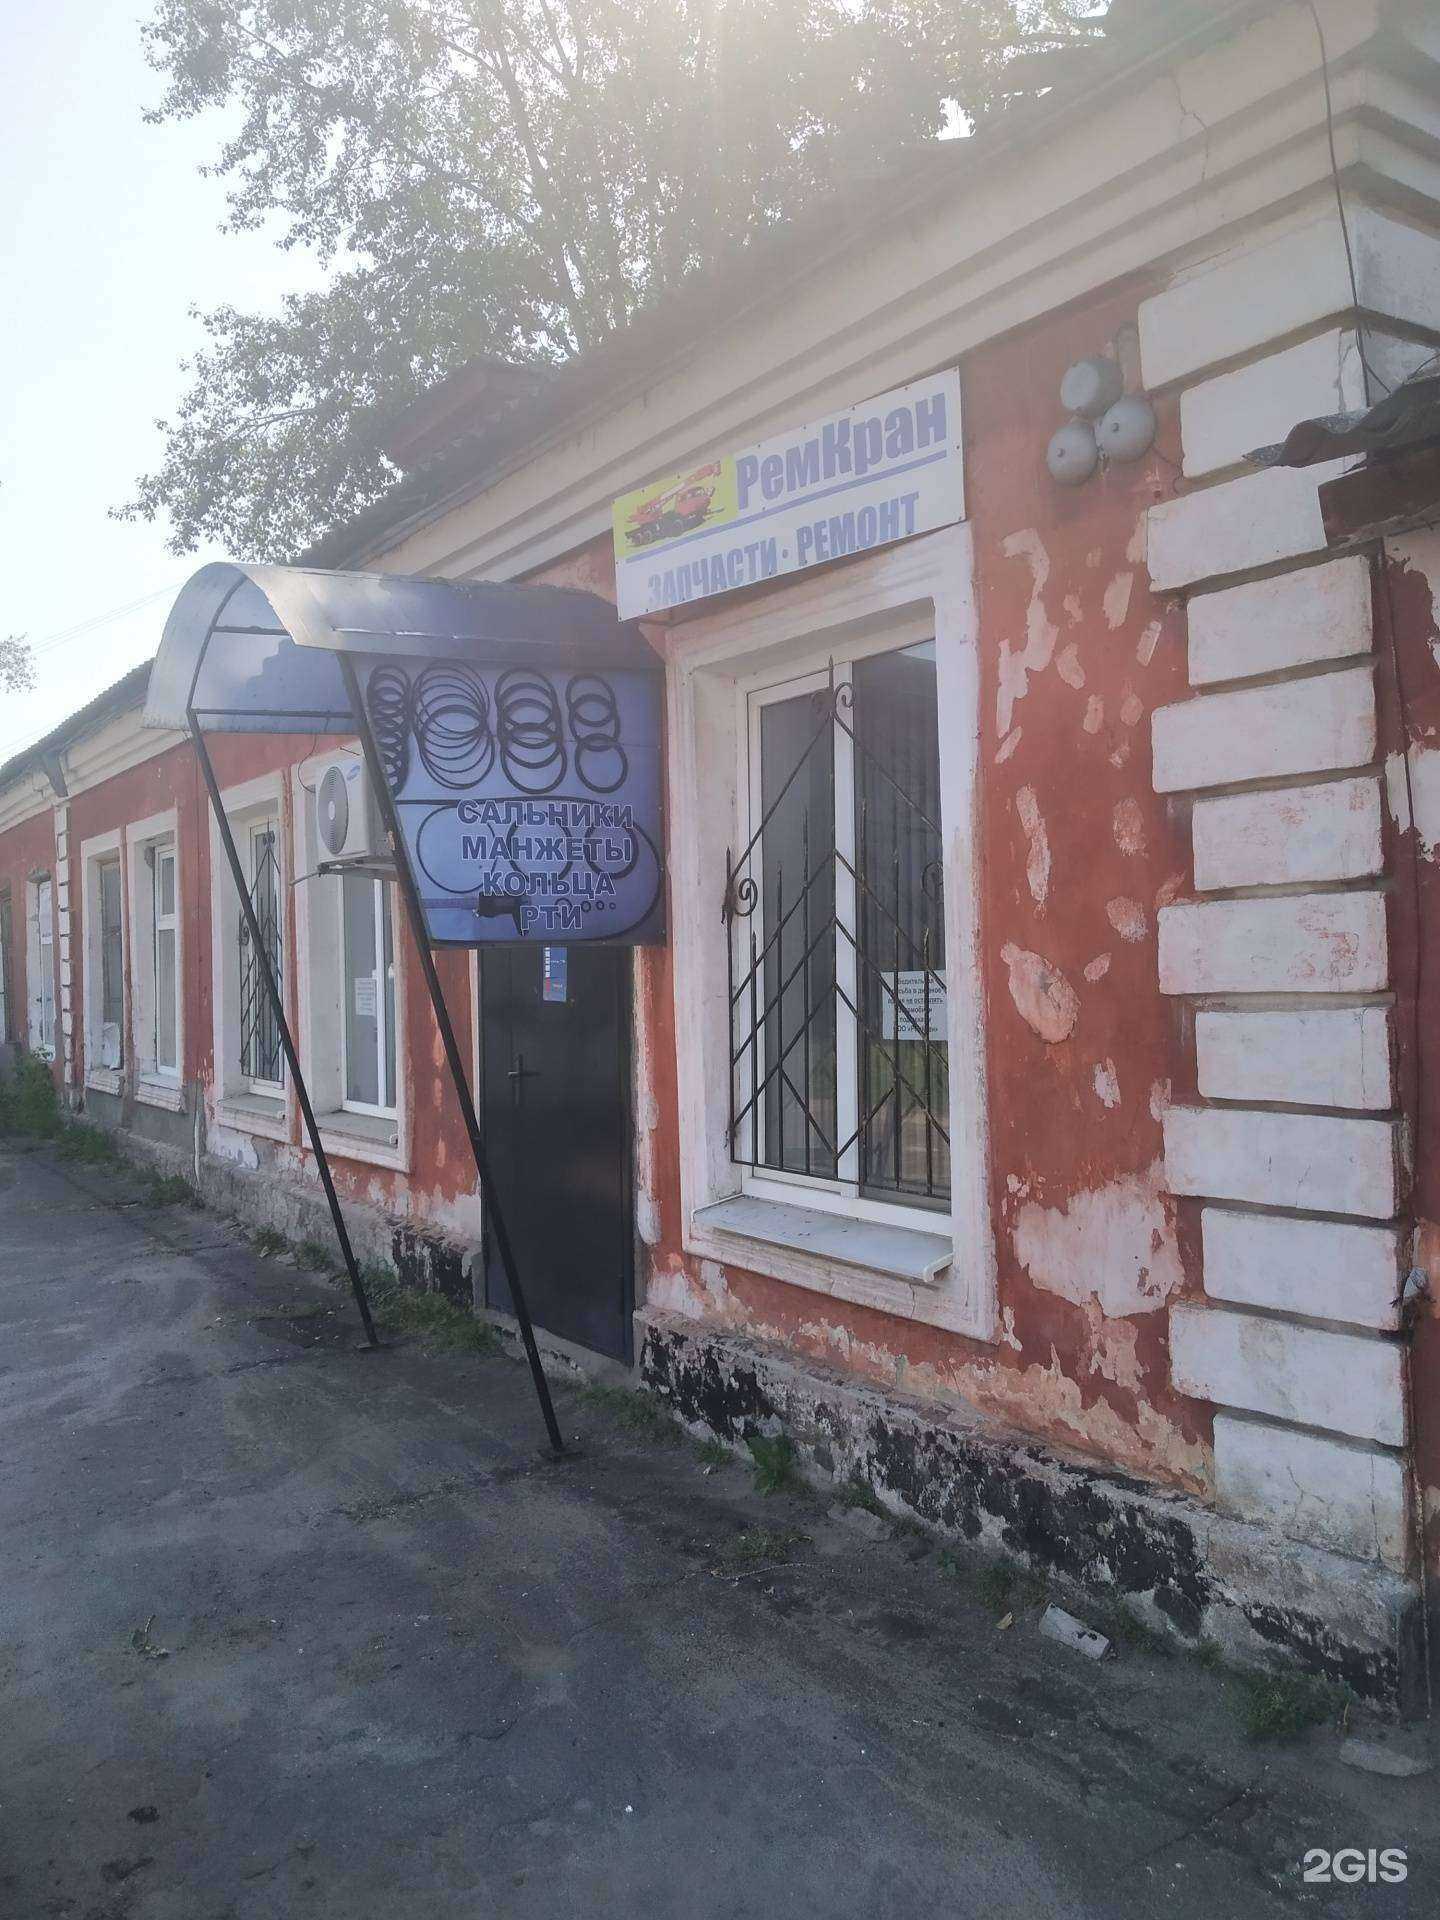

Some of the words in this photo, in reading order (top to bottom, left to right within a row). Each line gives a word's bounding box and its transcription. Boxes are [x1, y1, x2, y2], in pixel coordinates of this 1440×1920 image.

[736, 393, 947, 510] РемКран
[648, 537, 778, 606] ЗАПЧАСТИ
[796, 491, 919, 566] РЕМОНТ
[456, 800, 633, 828] САЛЬНИКИ
[461, 835, 632, 861] МАНЖЕТЫ
[482, 871, 616, 899] КОЛЬЦА
[520, 905, 584, 930] РТИ
